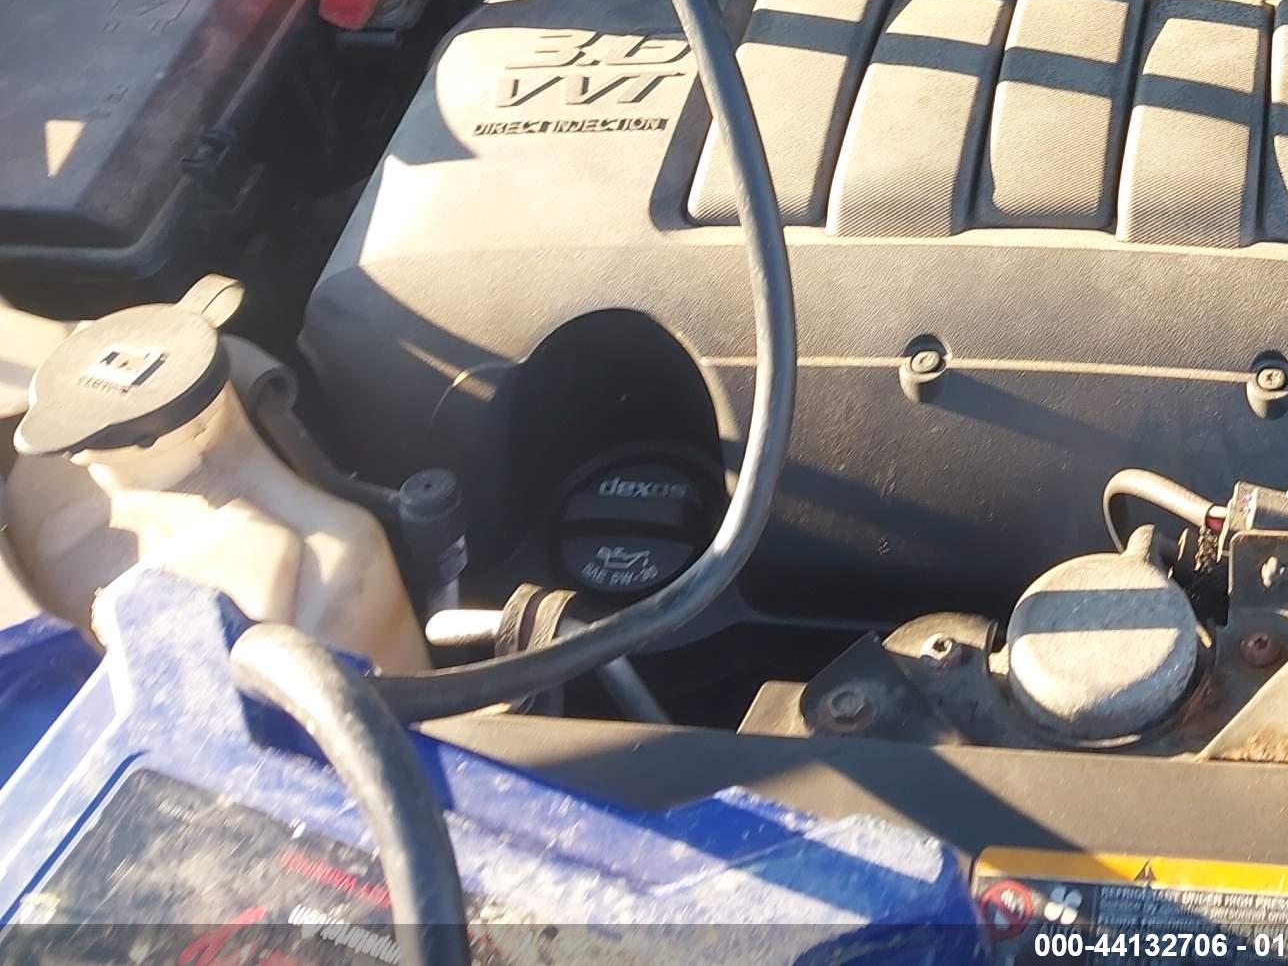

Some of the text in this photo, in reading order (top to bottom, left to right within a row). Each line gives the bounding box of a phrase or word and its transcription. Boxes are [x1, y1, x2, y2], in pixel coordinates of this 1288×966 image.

[495, 71, 686, 108] VVT
[472, 117, 670, 137] DIRECT INJECTION
[598, 476, 688, 498] dexos
